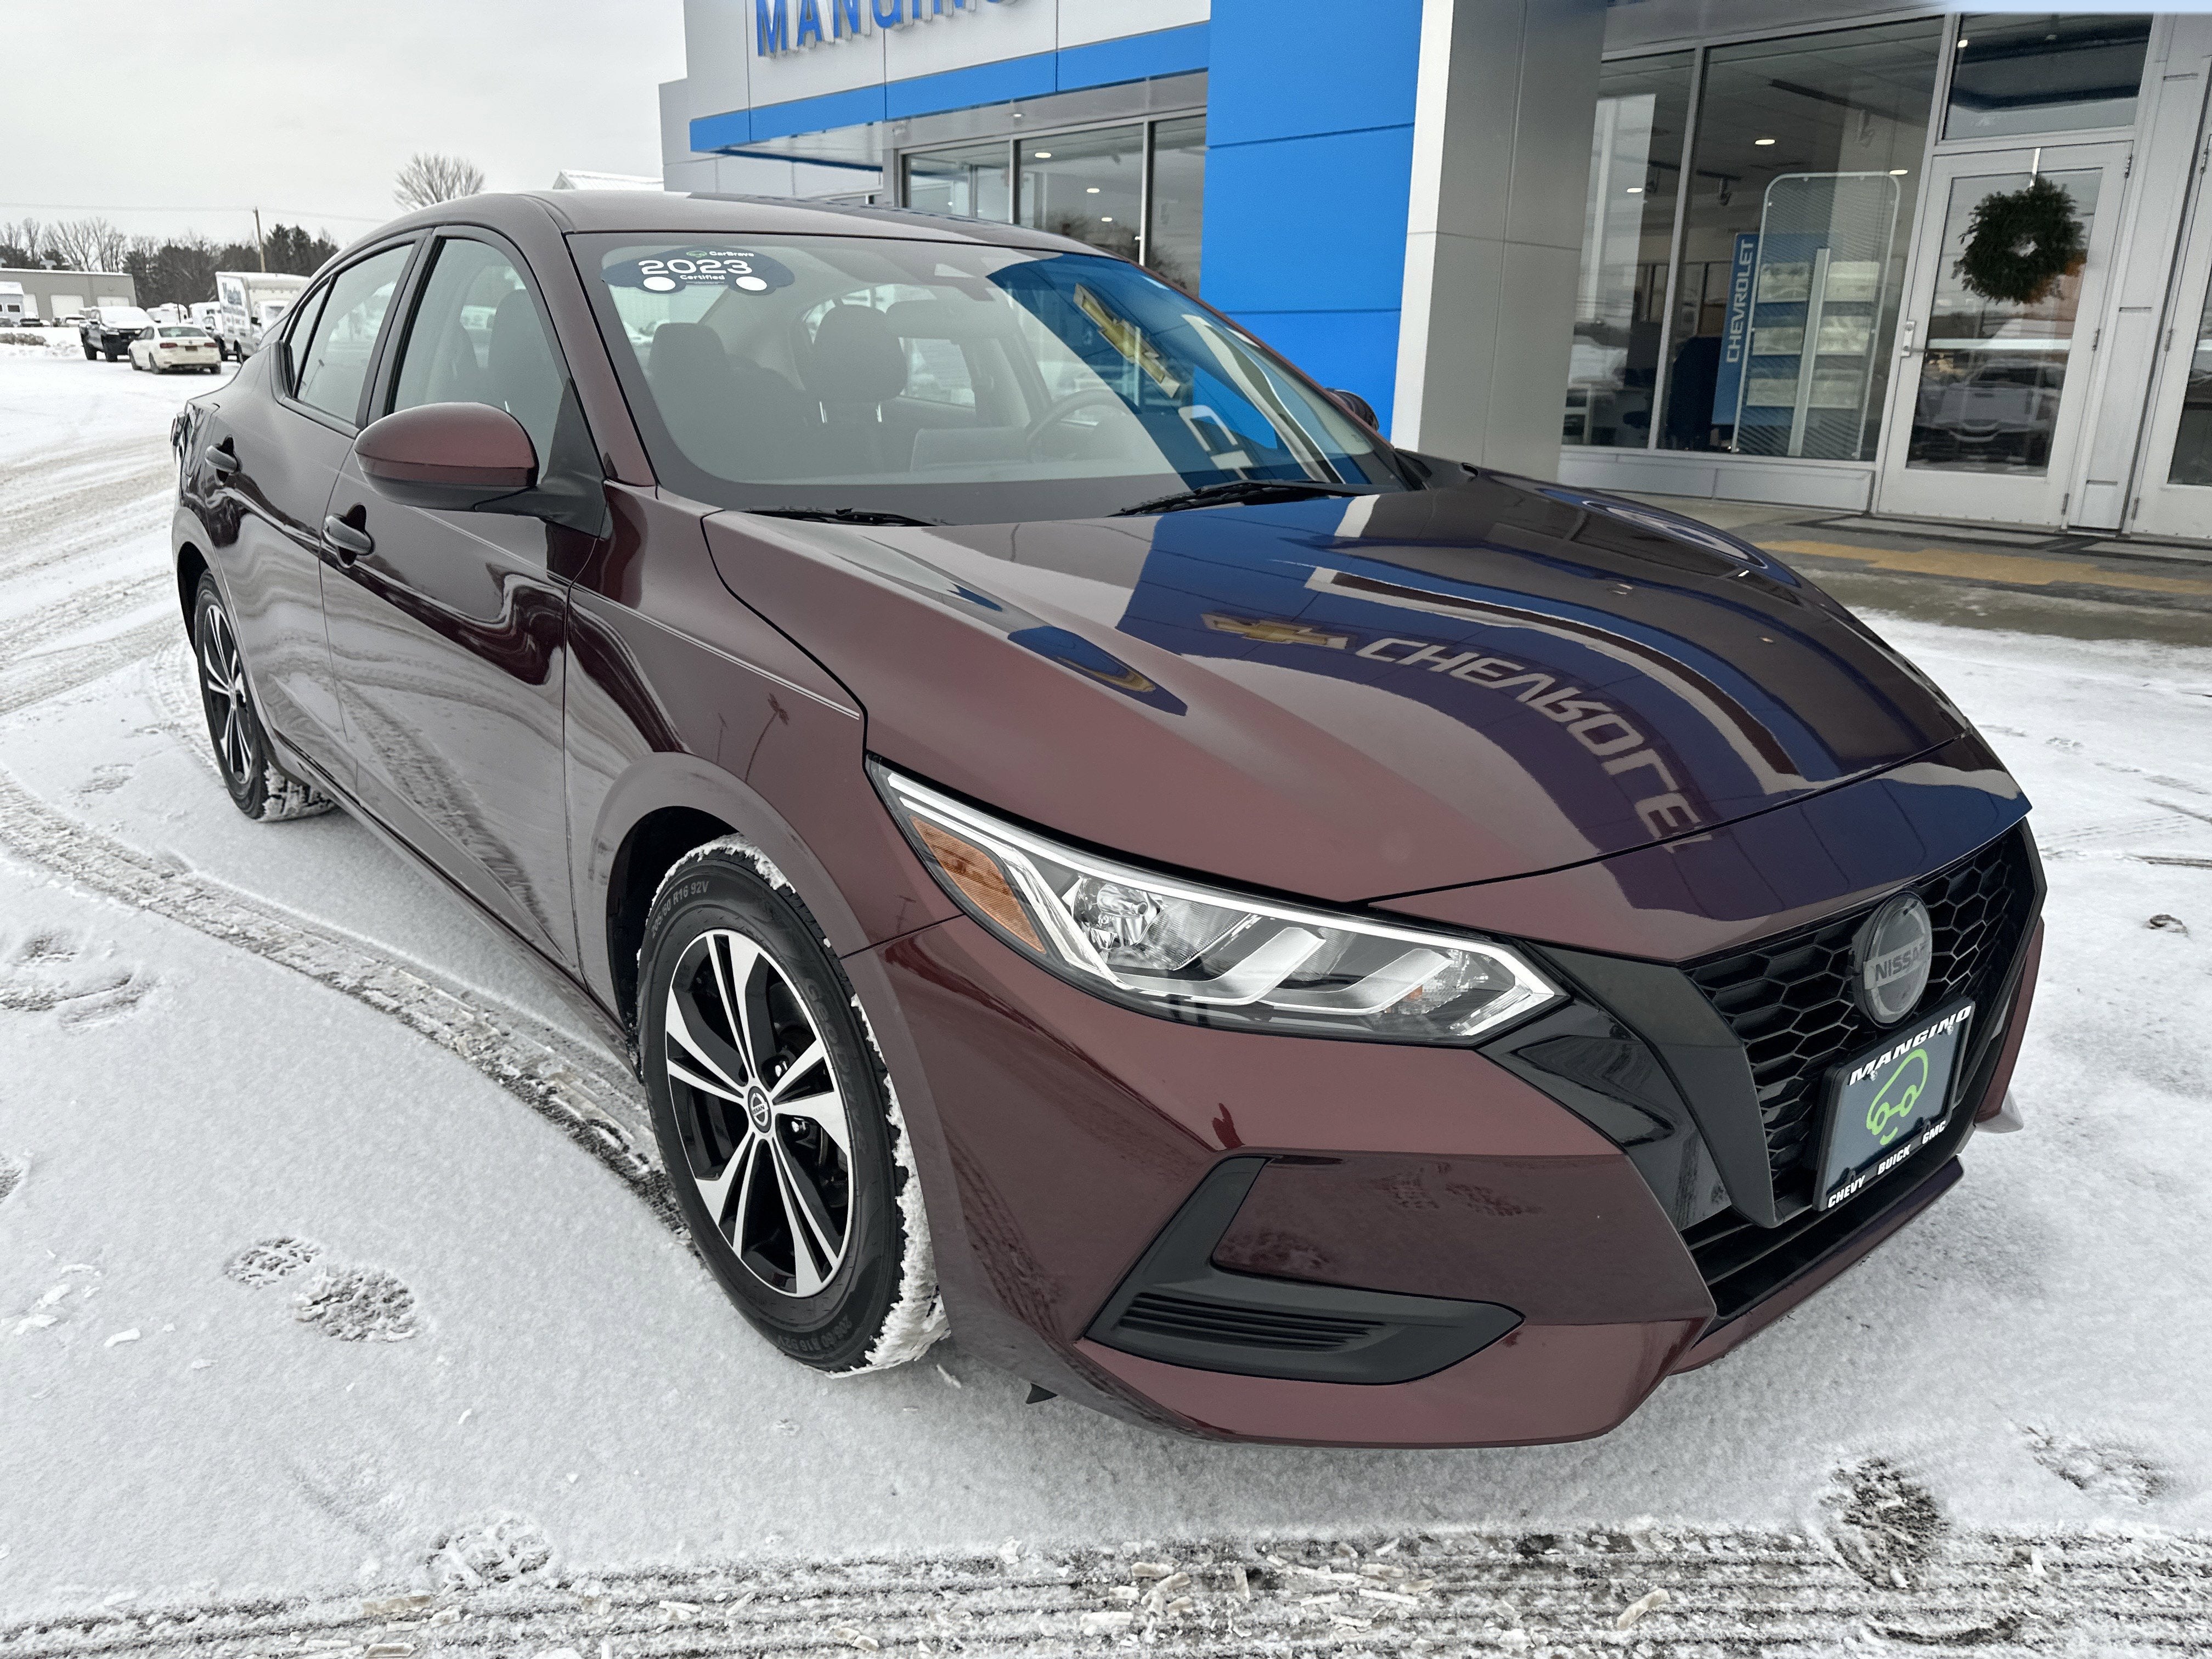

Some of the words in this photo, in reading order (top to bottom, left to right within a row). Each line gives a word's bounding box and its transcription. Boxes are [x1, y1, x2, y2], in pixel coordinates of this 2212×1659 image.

[638, 259, 753, 275] 2023
[1726, 239, 1754, 363] CHEVROLET
[673, 884, 689, 905] R16
[691, 881, 709, 895] 92V
[1875, 939, 1928, 981] NISSA
[1849, 1005, 1972, 1085] MANGINO
[1827, 1175, 1866, 1208] CHEVY
[1877, 1144, 1911, 1175] BUICK
[1922, 1120, 1946, 1144] GMC
